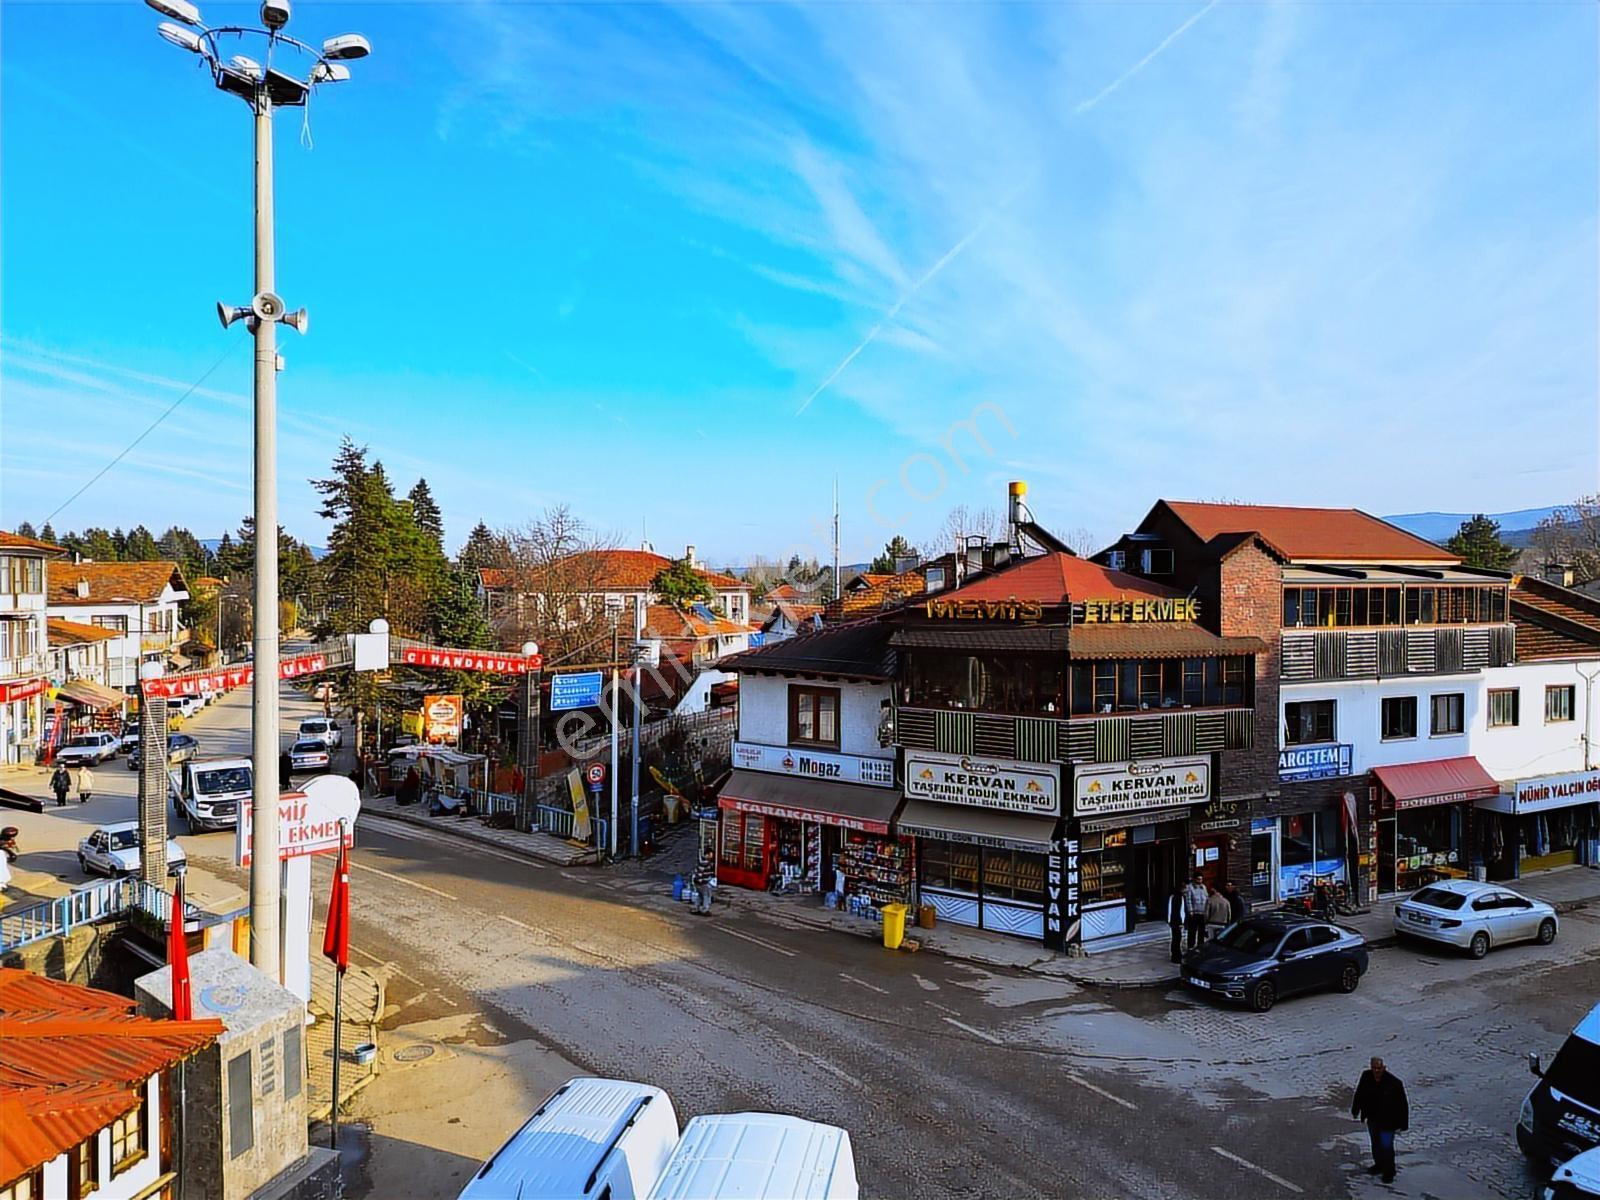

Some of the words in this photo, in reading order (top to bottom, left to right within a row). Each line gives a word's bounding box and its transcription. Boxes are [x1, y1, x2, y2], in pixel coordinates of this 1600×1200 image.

[282, 657, 326, 676] ULH
[799, 757, 841, 777] Mogaz
[944, 772, 1015, 790] KERVAN
[1112, 775, 1176, 791] KERVAN
[967, 788, 999, 800] ODUN
[1133, 789, 1161, 801] ODUN
[1518, 784, 1550, 804] MÜNİR
[1551, 780, 1585, 798] YALÇIN
[1048, 840, 1061, 932] KERVAN
[1068, 840, 1079, 917] EKMEK
